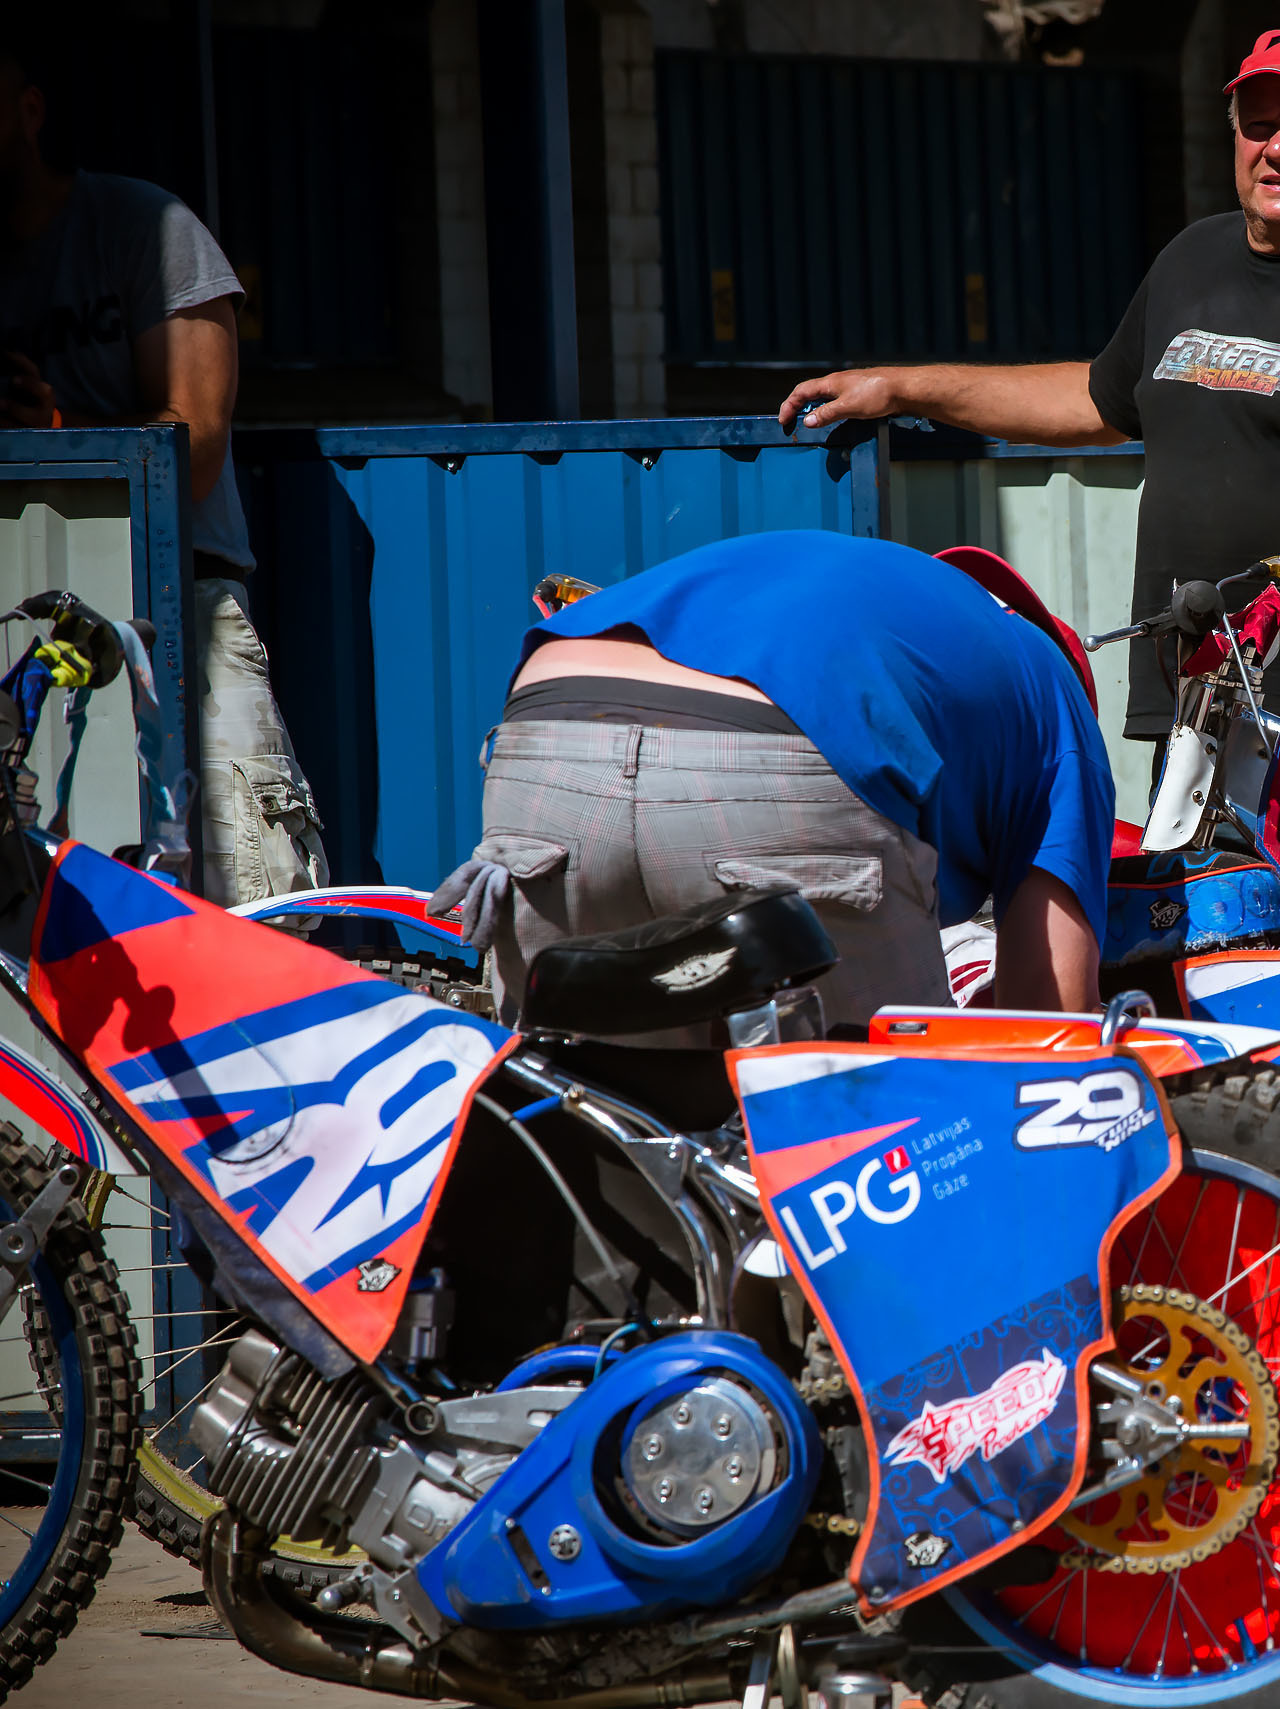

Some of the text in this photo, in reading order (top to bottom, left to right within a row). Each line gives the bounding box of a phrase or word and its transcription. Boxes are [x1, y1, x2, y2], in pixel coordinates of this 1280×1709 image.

[911, 1116, 971, 1155] Latvijas
[1014, 1068, 1143, 1150] 29
[780, 1158, 921, 1271] LPG
